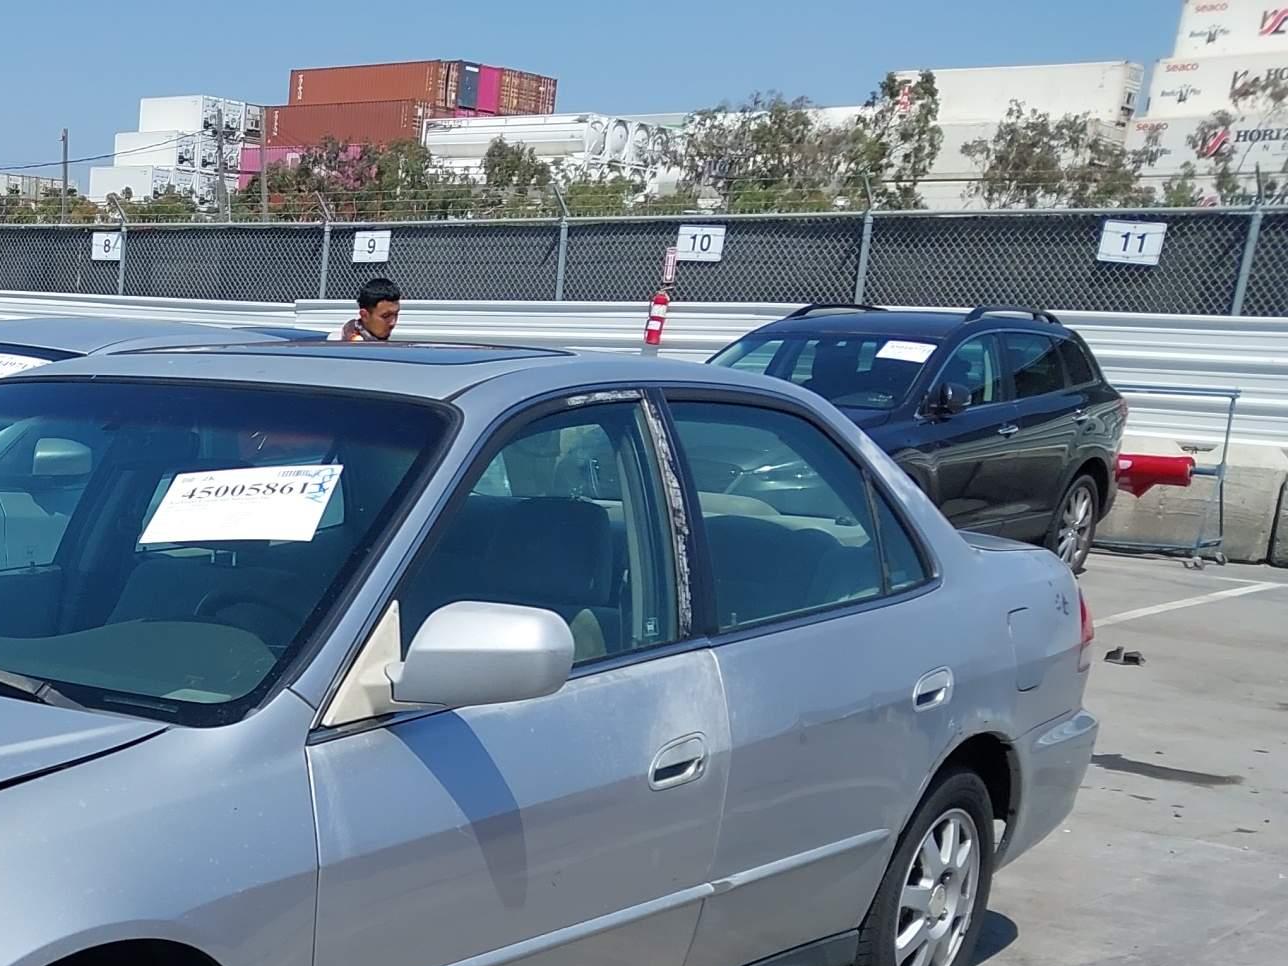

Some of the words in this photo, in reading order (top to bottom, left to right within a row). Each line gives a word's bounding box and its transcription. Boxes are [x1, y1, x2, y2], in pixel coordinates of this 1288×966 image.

[1195, 2, 1229, 13] seaco
[1165, 63, 1199, 73] seaco
[103, 238, 111, 253] 8
[367, 238, 376, 254] 9
[690, 233, 711, 252] 10
[1121, 231, 1146, 253] 11
[181, 482, 309, 499] 45005861
